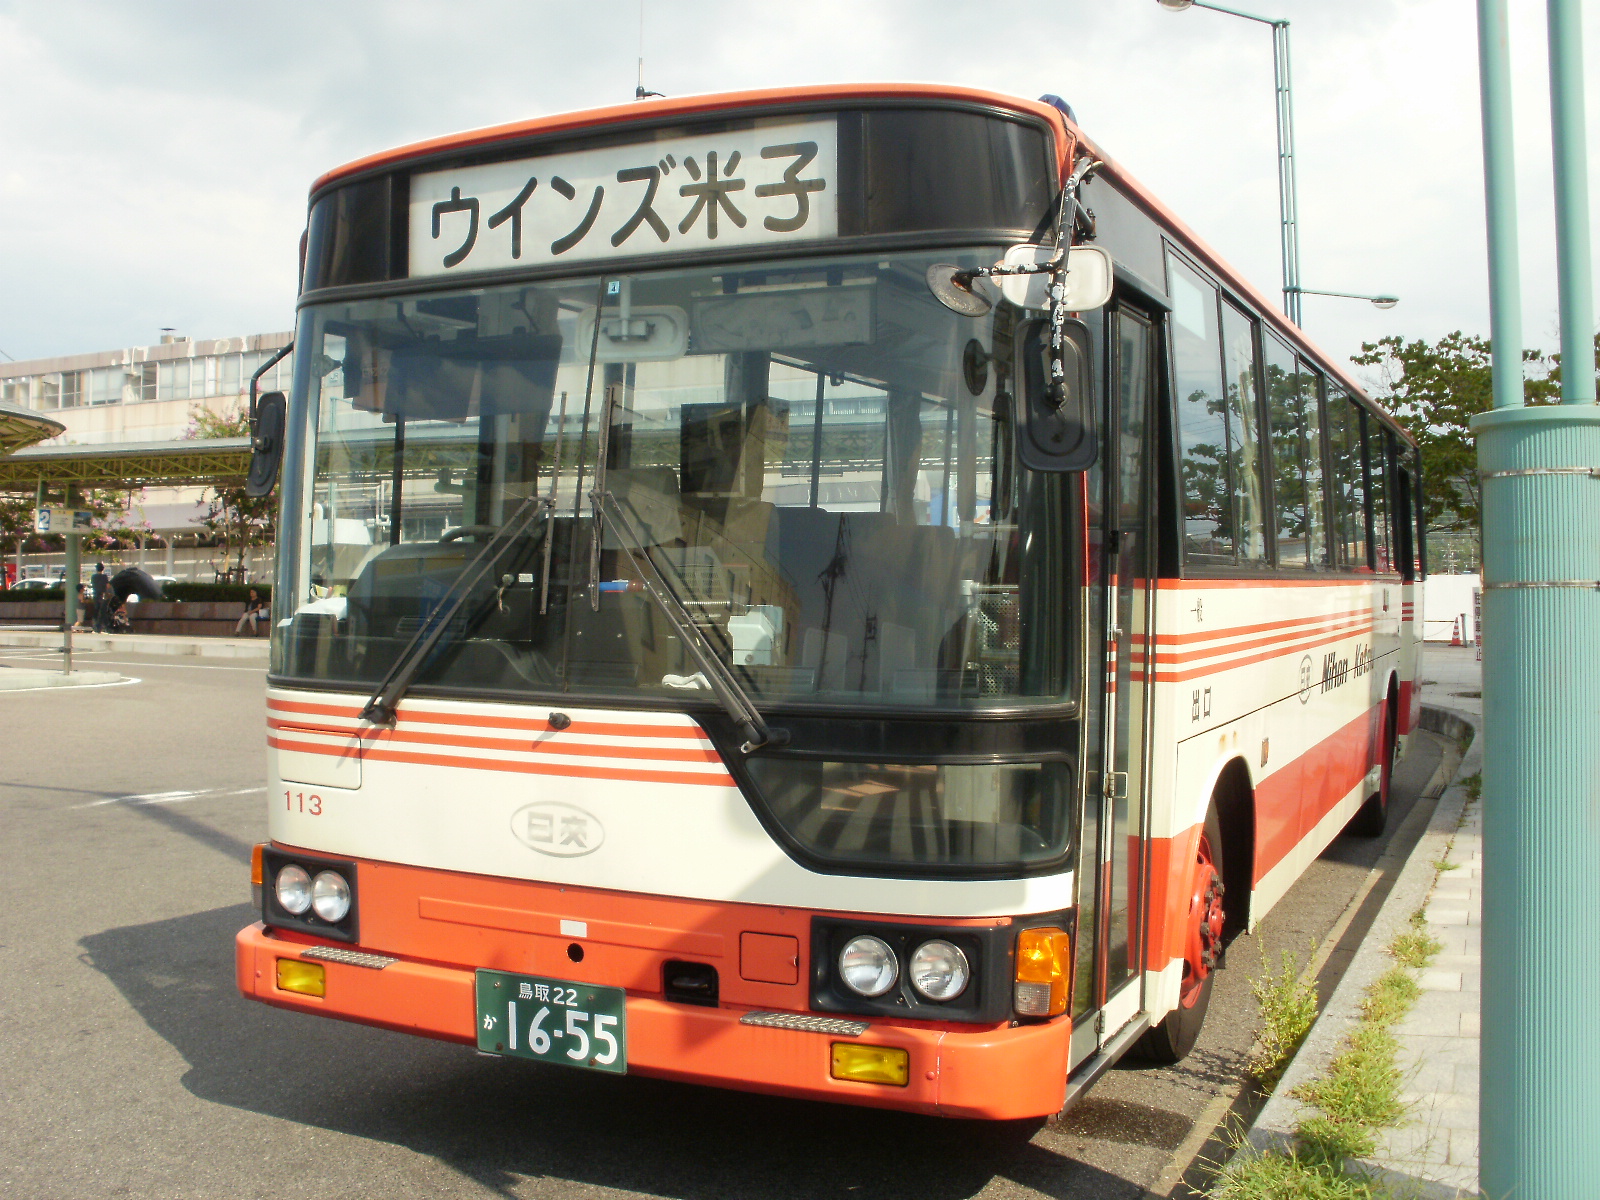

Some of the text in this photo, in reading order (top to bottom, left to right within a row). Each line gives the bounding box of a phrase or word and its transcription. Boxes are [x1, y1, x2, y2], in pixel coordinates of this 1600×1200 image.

[431, 140, 827, 269] ウインズ米子
[39, 511, 50, 529] 2
[1321, 651, 1349, 694] Nihon
[1191, 685, 1212, 724] 出口
[284, 790, 323, 816] 113
[527, 811, 588, 848] 日交
[483, 1014, 498, 1030] か
[508, 1000, 618, 1065] 16-55
